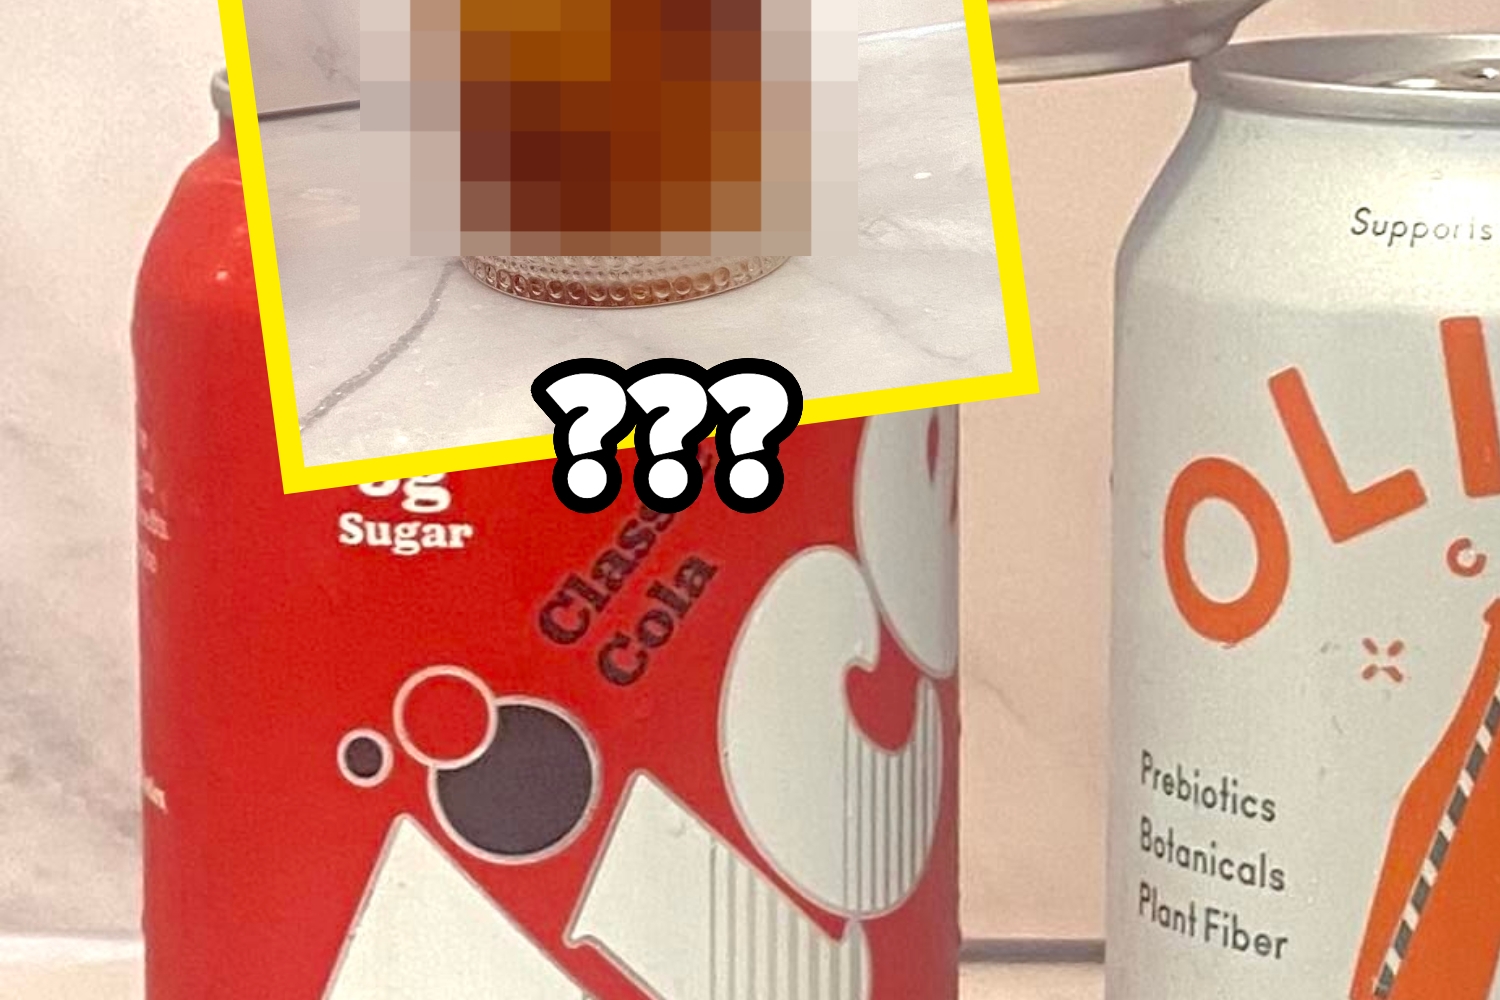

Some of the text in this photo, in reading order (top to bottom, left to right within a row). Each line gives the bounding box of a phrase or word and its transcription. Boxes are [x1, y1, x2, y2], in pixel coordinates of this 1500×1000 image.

[1351, 206, 1493, 247] Supports
[339, 511, 474, 556] Sugar
[597, 555, 718, 687] Cola
[1141, 748, 1277, 823] Prebiotics
[1140, 816, 1286, 892] Botanicals
[1139, 881, 1288, 960] Plant Fiber
